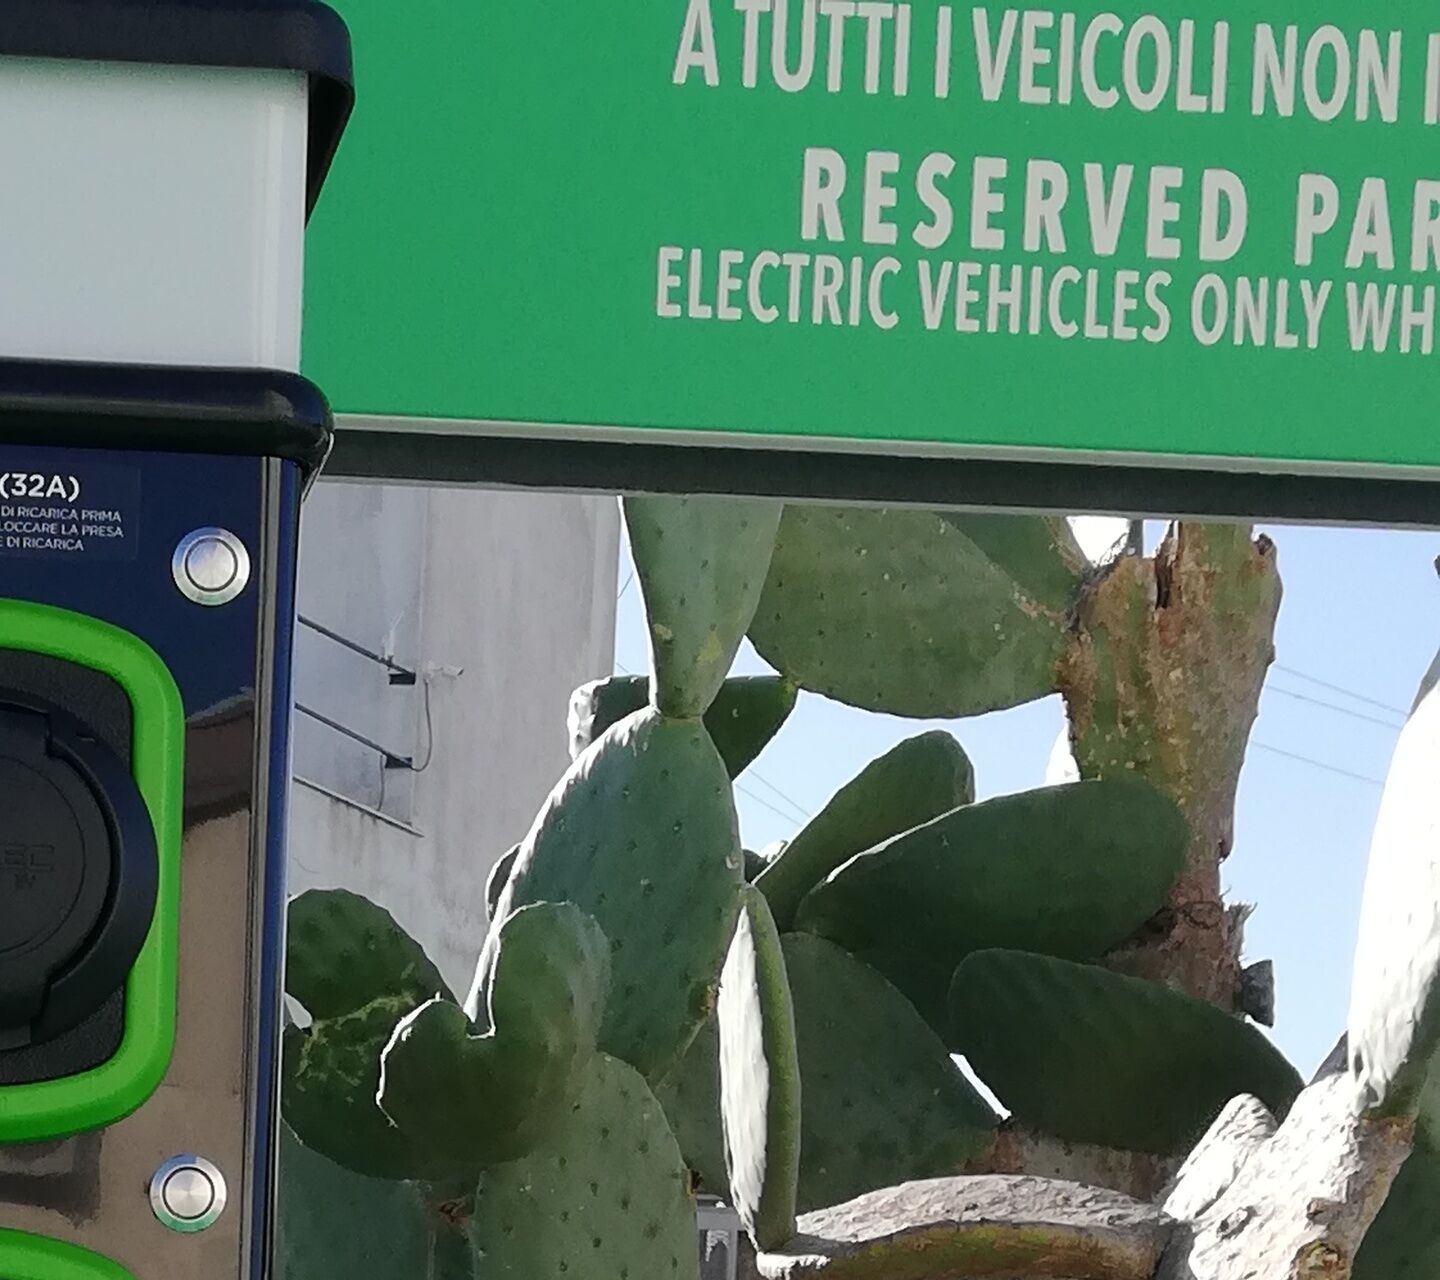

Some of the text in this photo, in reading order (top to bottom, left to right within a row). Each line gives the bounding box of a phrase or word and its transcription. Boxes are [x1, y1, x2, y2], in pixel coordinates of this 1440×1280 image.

[672, 0, 720, 87] A
[734, 0, 912, 97] TUTTI
[934, 5, 952, 98] I
[972, 7, 1229, 113] VEICOLI
[1251, 23, 1402, 123] NON
[799, 147, 1440, 272] RESERVED PAR
[656, 246, 1437, 355] ELECTRIC VEHICLES ONLY WH
[1, 505, 15, 517] DI
[17, 506, 79, 521] RICARICA
[81, 509, 122, 523] PRIMA
[6, 536, 20, 548] DI
[22, 536, 85, 551] RICARICA
[61, 523, 79, 535] LA
[81, 524, 124, 538] PRESA
